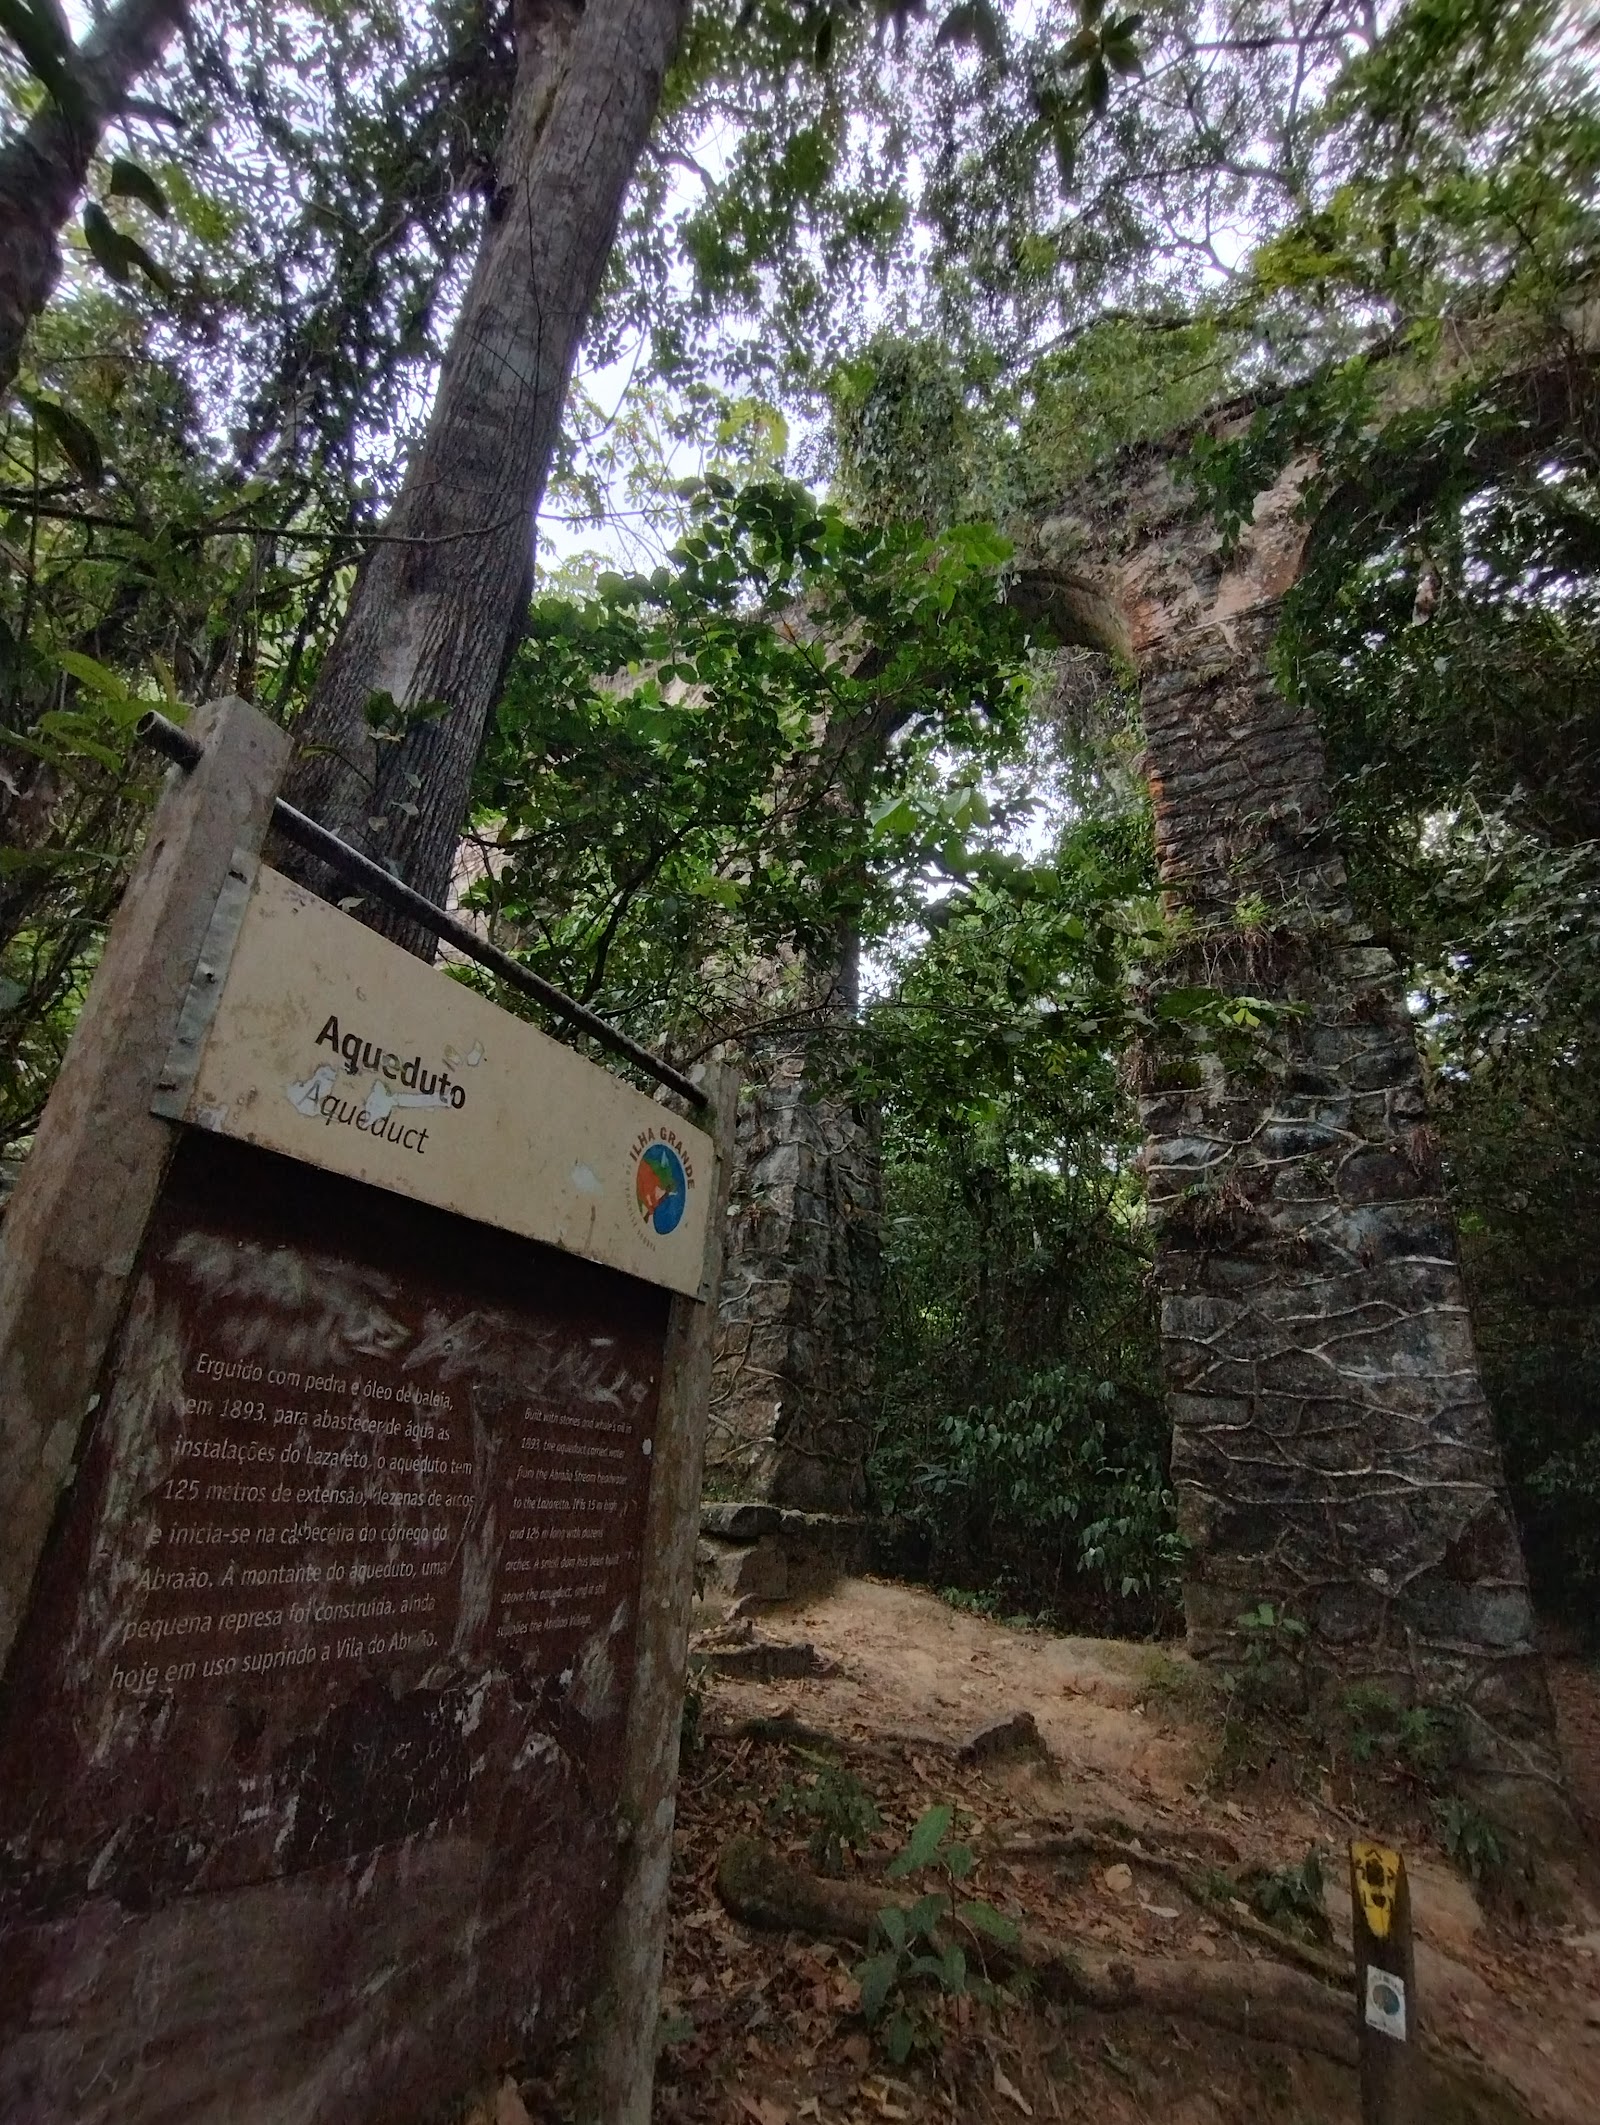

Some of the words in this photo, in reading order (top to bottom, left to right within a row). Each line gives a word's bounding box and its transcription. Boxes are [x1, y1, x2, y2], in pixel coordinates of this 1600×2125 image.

[315, 1015, 466, 1109] Aqueduto
[298, 1079, 429, 1154] Aqueduct
[630, 1128, 655, 1162] ILHA
[660, 1127, 695, 1190] GRANDE
[196, 1353, 263, 1381] Erguido
[267, 1369, 301, 1387] com
[305, 1373, 346, 1394] pedra
[351, 1381, 360, 1395] e
[363, 1380, 392, 1400] óleo
[396, 1386, 411, 1403] de
[415, 1387, 453, 1411] baleia,
[185, 1399, 213, 1416] em
[273, 1408, 308, 1428] para
[312, 1409, 383, 1434] abastecer
[385, 1418, 401, 1435] de
[405, 1420, 434, 1442] água
[438, 1428, 450, 1440] as
[174, 1434, 276, 1465] instalações
[280, 1444, 300, 1464] do
[378, 1455, 386, 1469] o
[390, 1455, 447, 1475] aqueduto
[163, 1479, 200, 1501] 125
[205, 1482, 267, 1502] metros
[272, 1482, 292, 1503] de
[297, 1485, 367, 1508] extensão,
[373, 1486, 424, 1507] dezenas
[428, 1489, 442, 1507] de
[445, 1494, 475, 1507] arcos
[169, 1521, 251, 1544] inicia-se
[257, 1527, 276, 1544] na
[359, 1522, 377, 1542] do
[432, 1523, 448, 1541] do
[136, 1566, 213, 1592] Abraão.
[241, 1563, 322, 1586] montante
[326, 1560, 345, 1581] do
[350, 1560, 417, 1587] aqueduto,
[422, 1560, 448, 1576] uma
[122, 1614, 211, 1646] pequena
[218, 1606, 282, 1632] represa
[289, 1600, 312, 1623] foi
[401, 1593, 436, 1613] ainda
[109, 1661, 159, 1691] hoje
[165, 1659, 195, 1682] em
[202, 1656, 237, 1678] uso
[241, 1643, 316, 1676] suprindo
[321, 1645, 331, 1661] a
[336, 1636, 363, 1660] Vila
[368, 1634, 386, 1654] do
